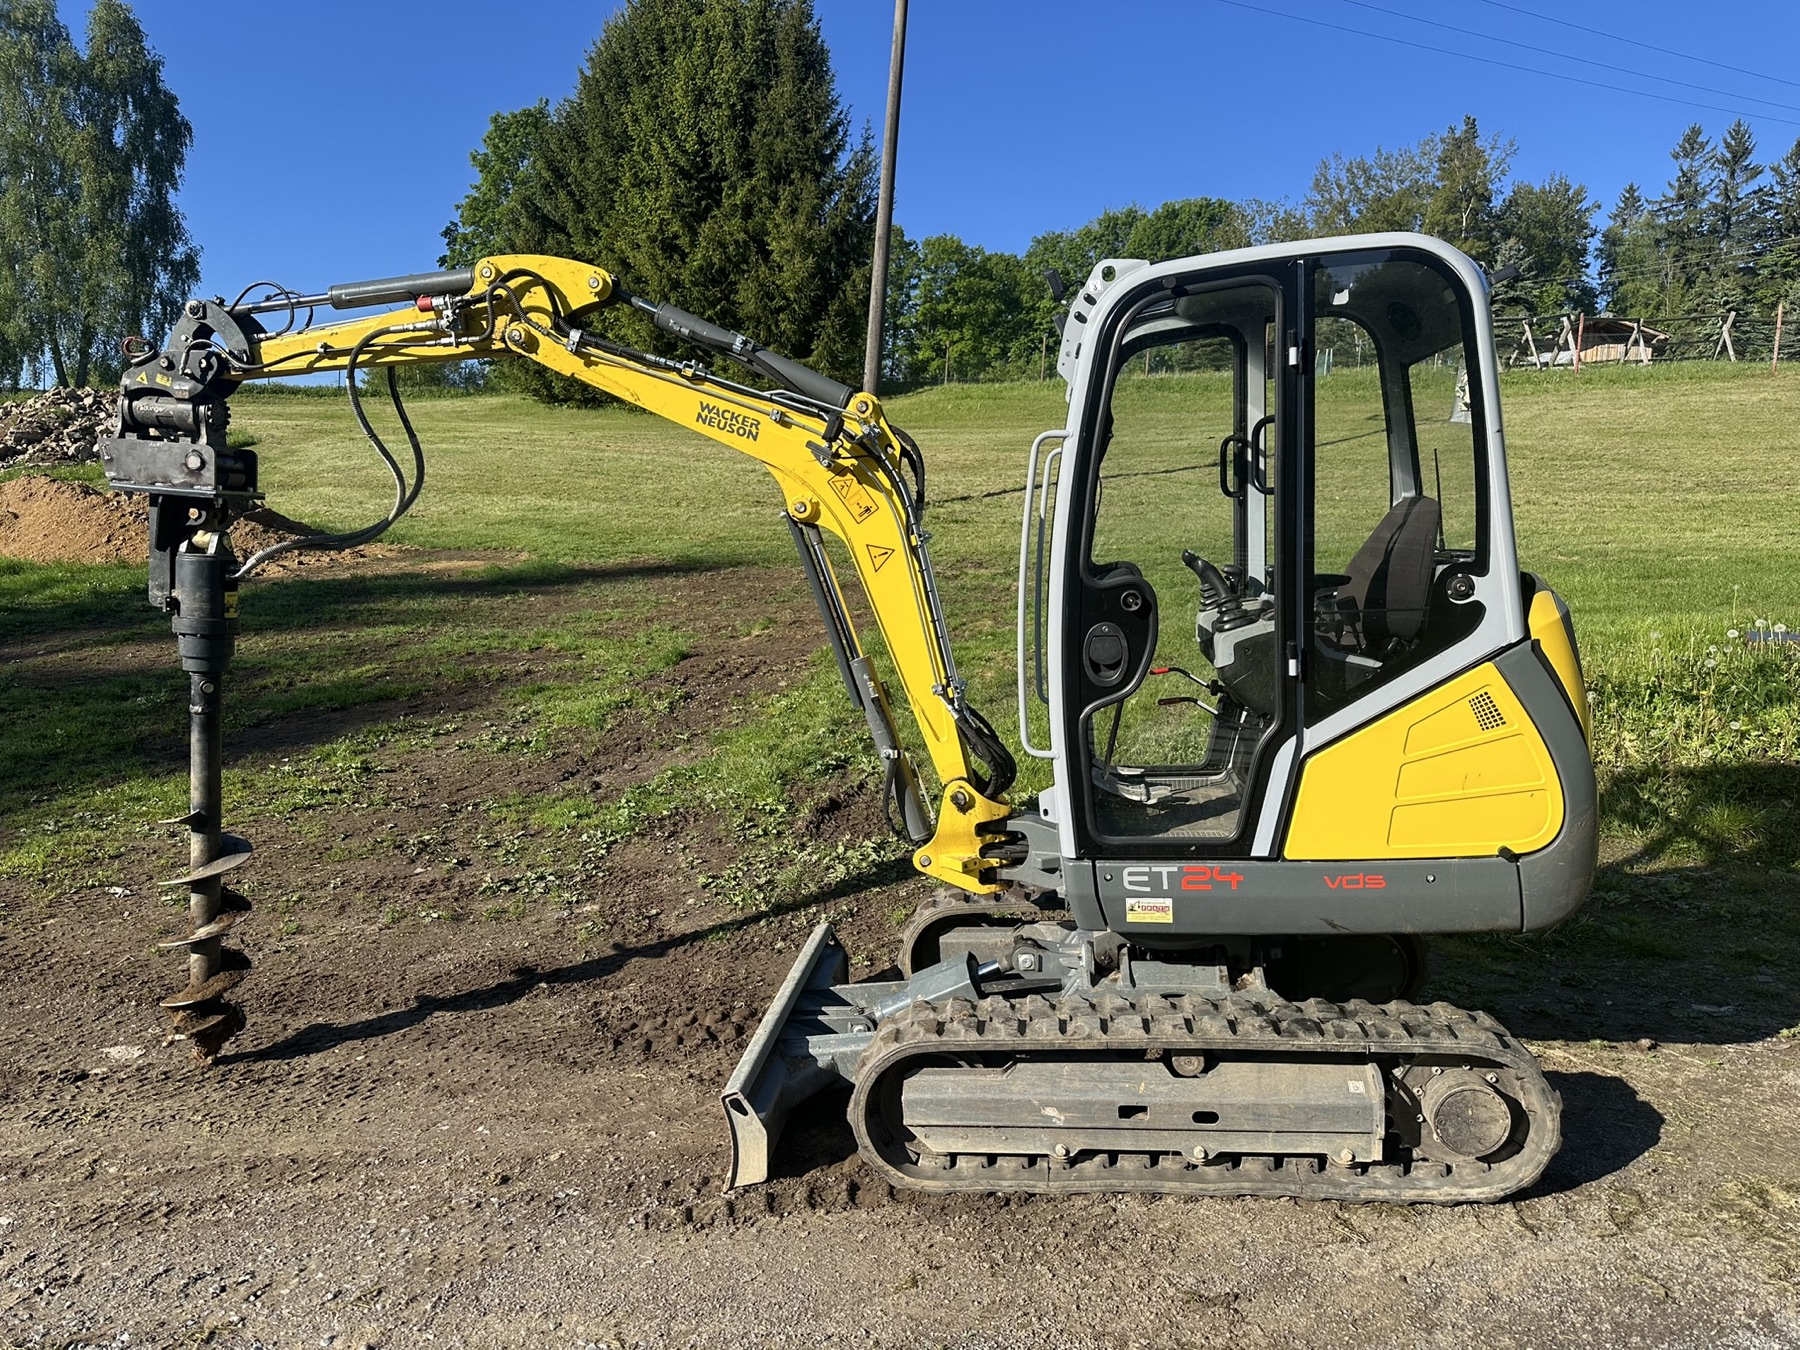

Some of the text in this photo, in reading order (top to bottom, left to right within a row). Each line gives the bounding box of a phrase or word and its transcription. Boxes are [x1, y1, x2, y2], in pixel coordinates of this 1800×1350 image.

[695, 412, 760, 442] NEUSON
[699, 400, 761, 430] WACKER
[1122, 866, 1244, 892] ET24
[1323, 872, 1387, 890] vds
